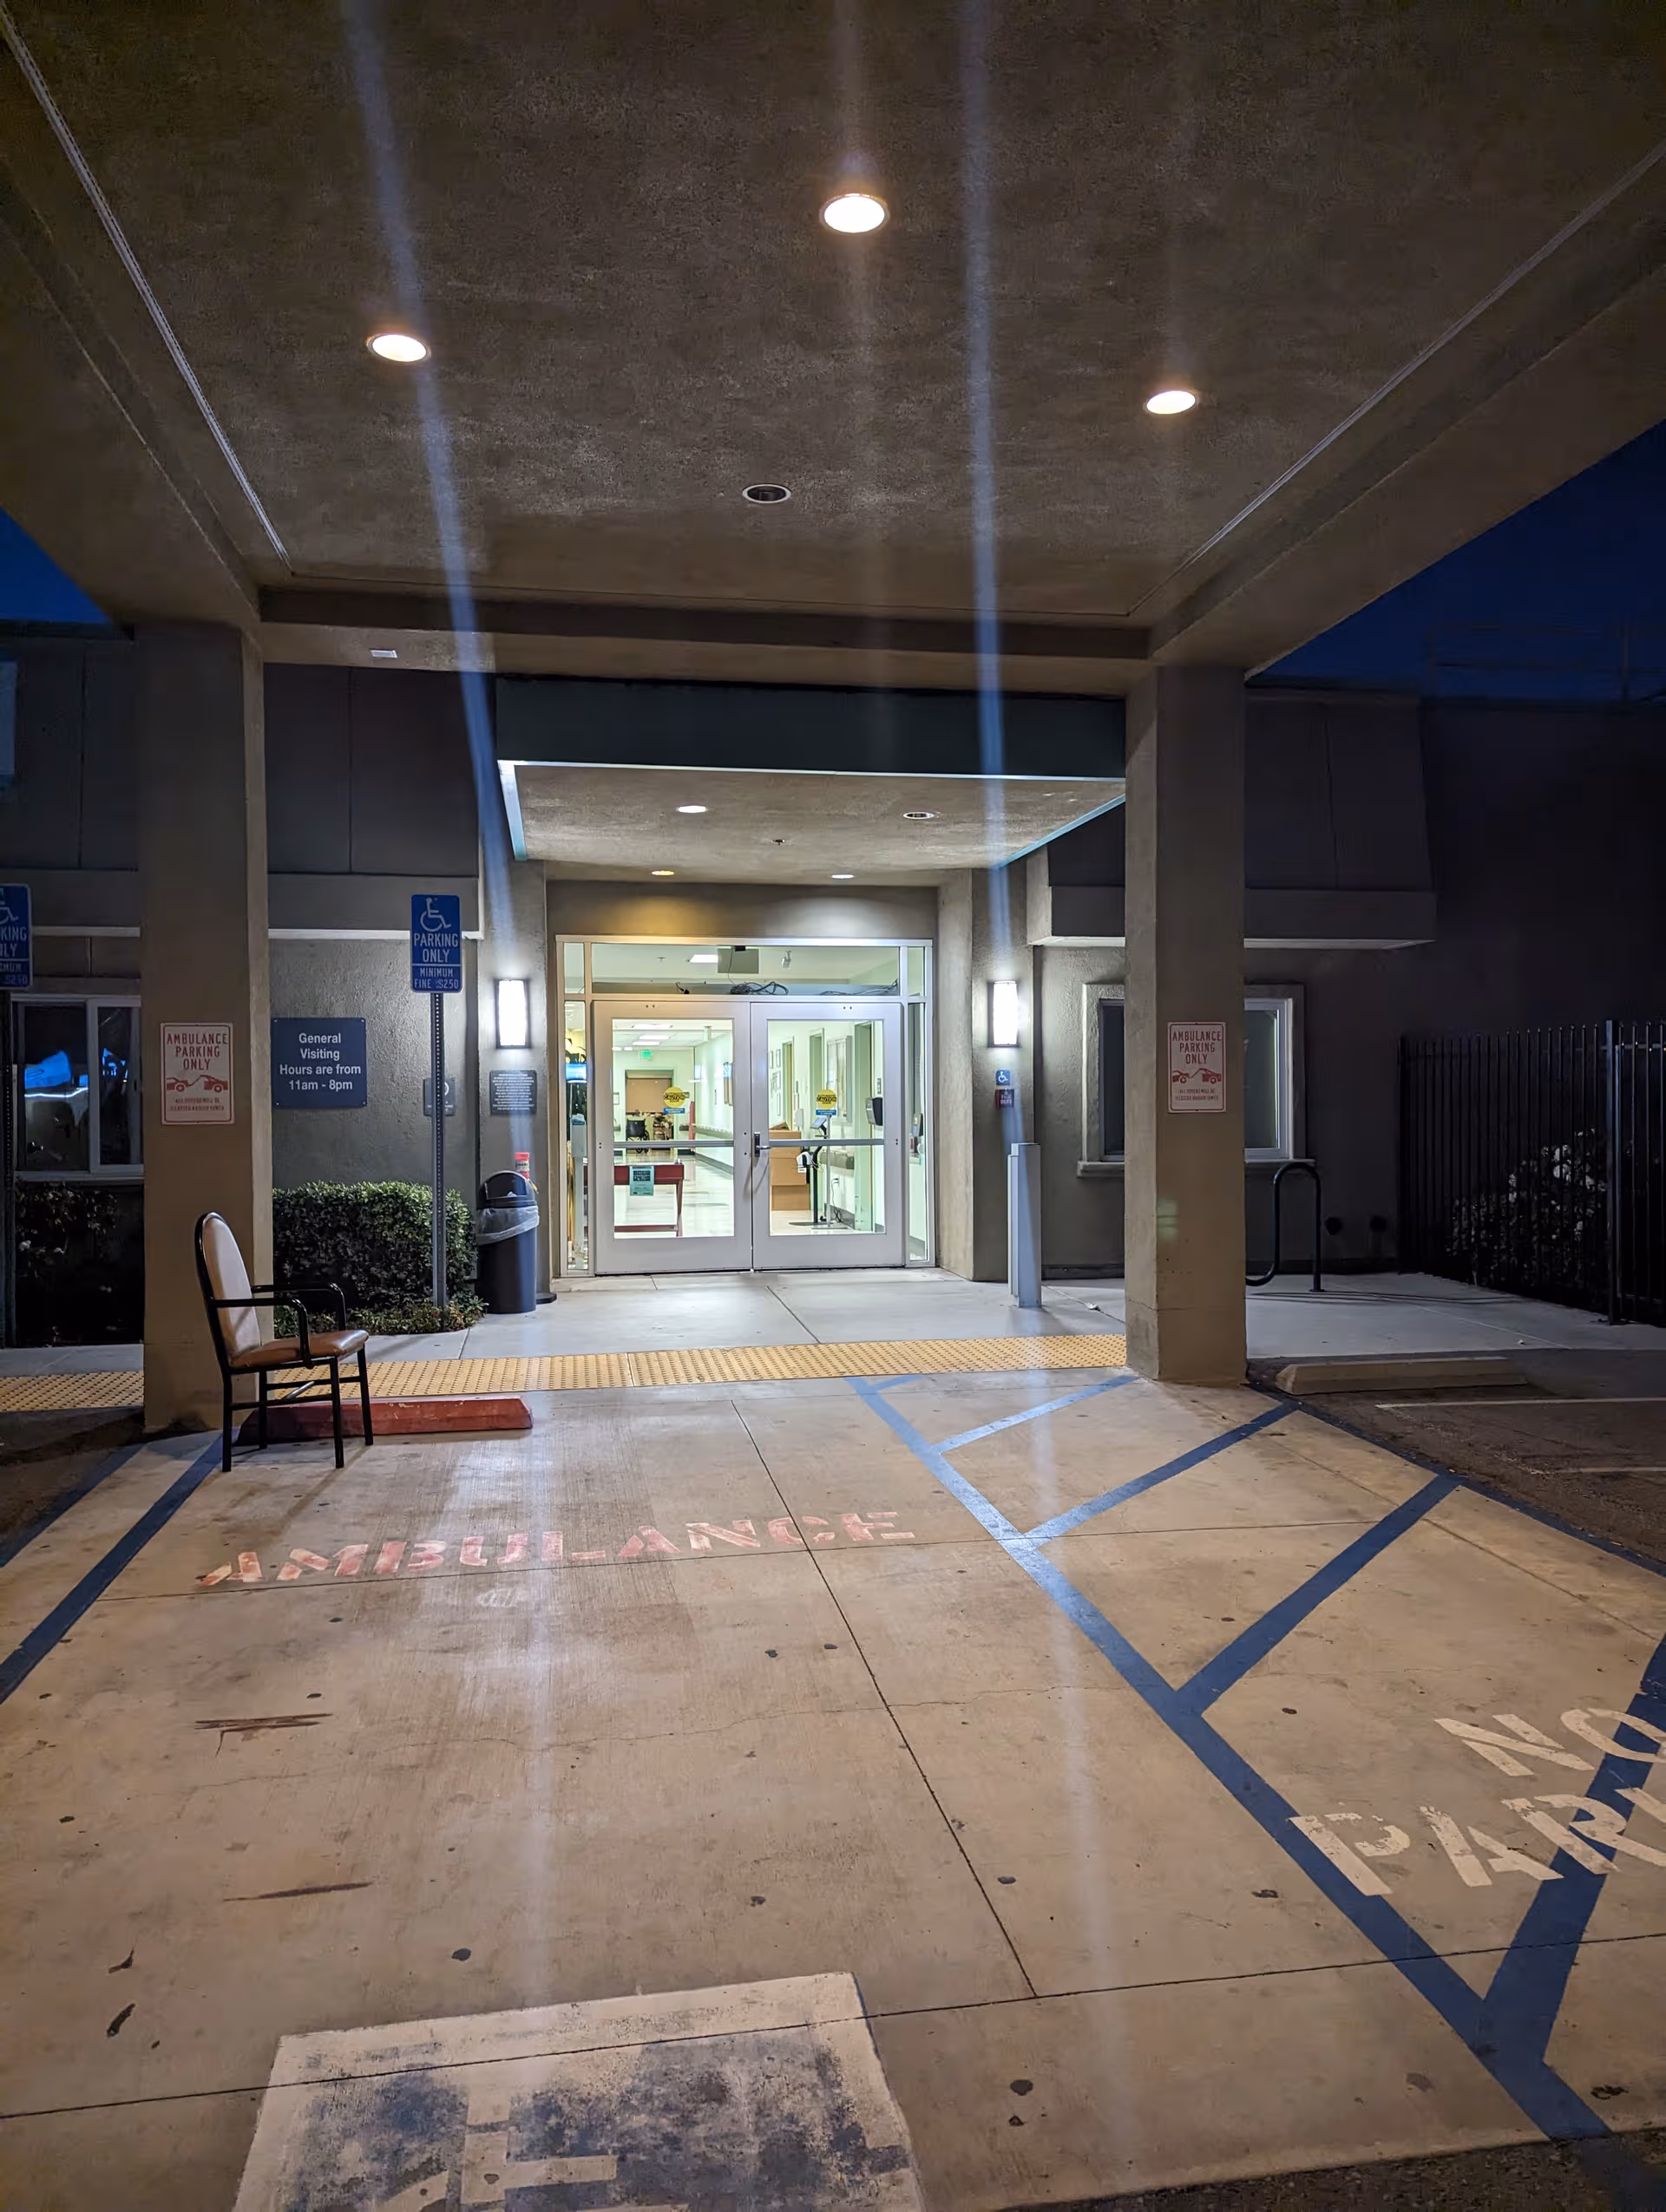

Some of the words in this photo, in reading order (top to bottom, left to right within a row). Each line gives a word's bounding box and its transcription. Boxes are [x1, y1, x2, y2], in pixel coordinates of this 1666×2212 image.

[0, 926, 27, 941] KING
[414, 933, 459, 947] PARKING
[423, 948, 450, 963] ONLY
[420, 967, 454, 978] MINIMUM
[414, 978, 431, 989] FINE
[167, 1033, 228, 1044] AMBULANCE
[298, 1032, 341, 1044] General
[1172, 1031, 1222, 1042] AMBULANCE
[175, 1045, 220, 1057] PARKING
[1180, 1042, 1215, 1053] PARKING
[300, 1048, 340, 1062] Visiting
[1185, 1053, 1208, 1064] ONLY
[183, 1058, 210, 1070] ONLY
[279, 1063, 312, 1075] Hours
[315, 1065, 333, 1075] are
[336, 1063, 361, 1075] from
[289, 1079, 318, 1090] 11am
[329, 1079, 353, 1092] 8pm
[196, 1511, 916, 1587] AMBULANCE
[1434, 1708, 1666, 1777] NO
